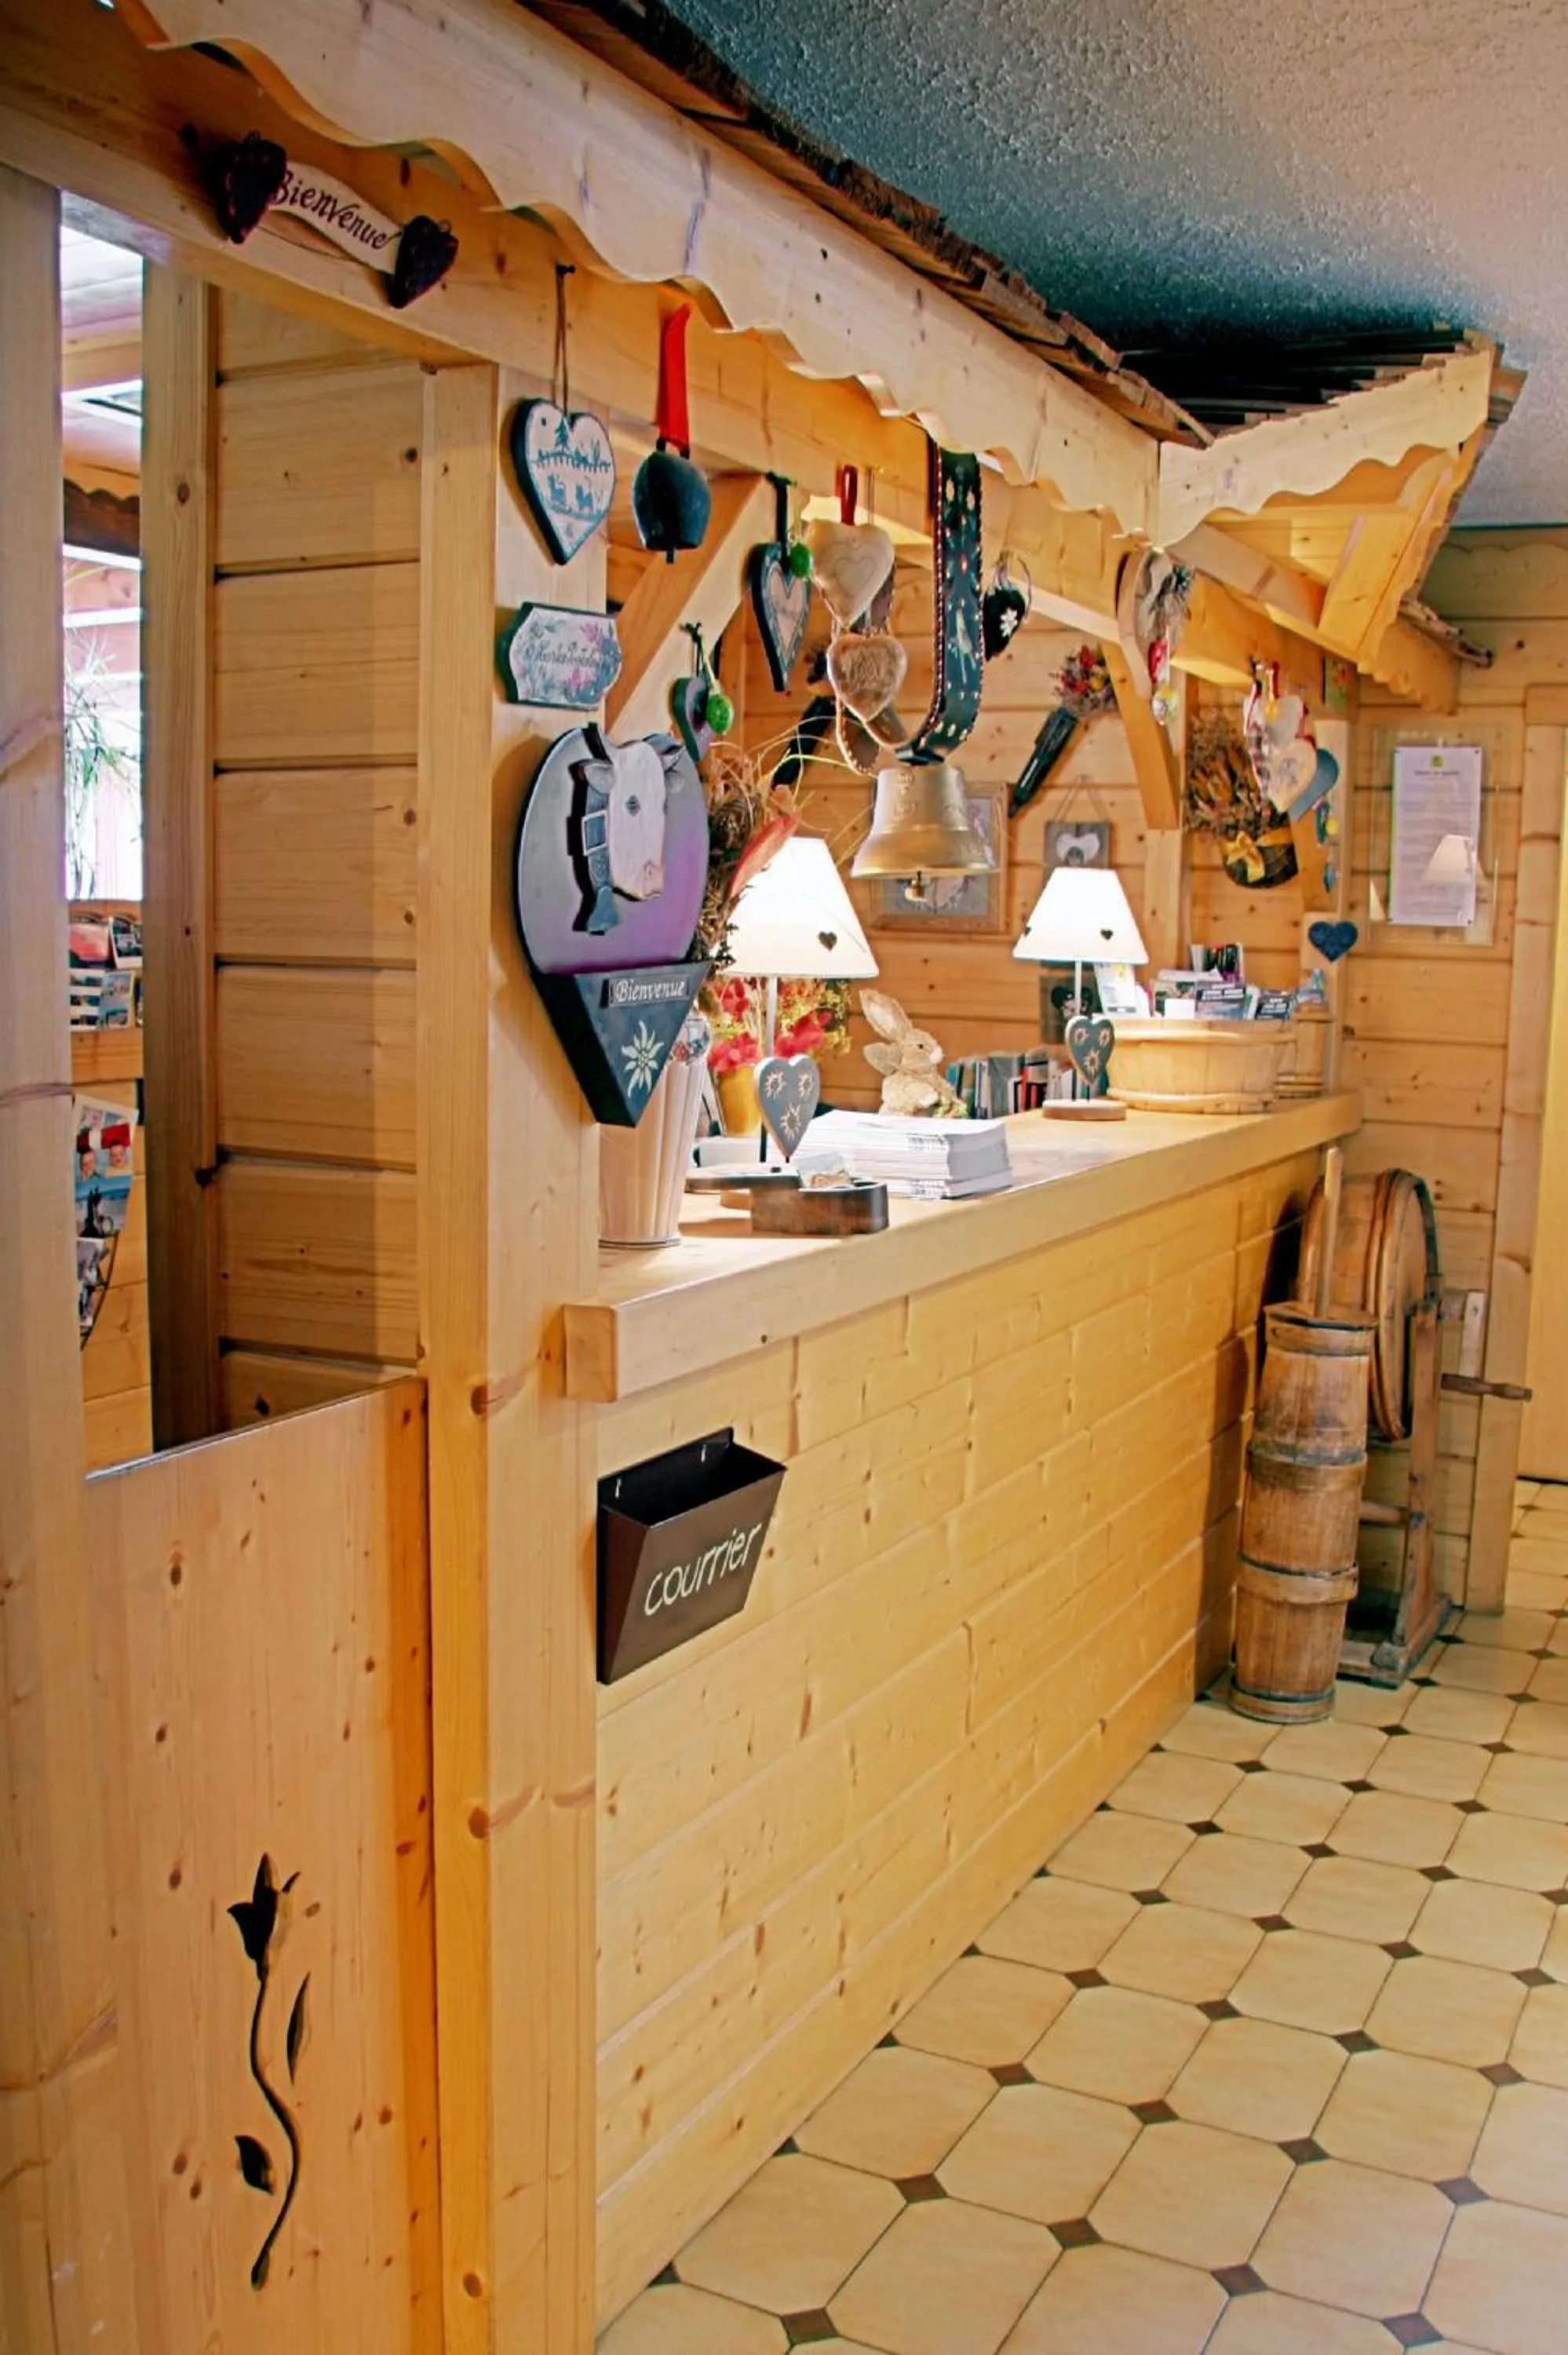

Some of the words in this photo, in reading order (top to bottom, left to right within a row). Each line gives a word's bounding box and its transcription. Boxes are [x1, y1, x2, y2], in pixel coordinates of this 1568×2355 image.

[274, 170, 401, 250] Bienvenue
[616, 980, 685, 1002] Bienvenue
[644, 1524, 762, 1616] courrier
